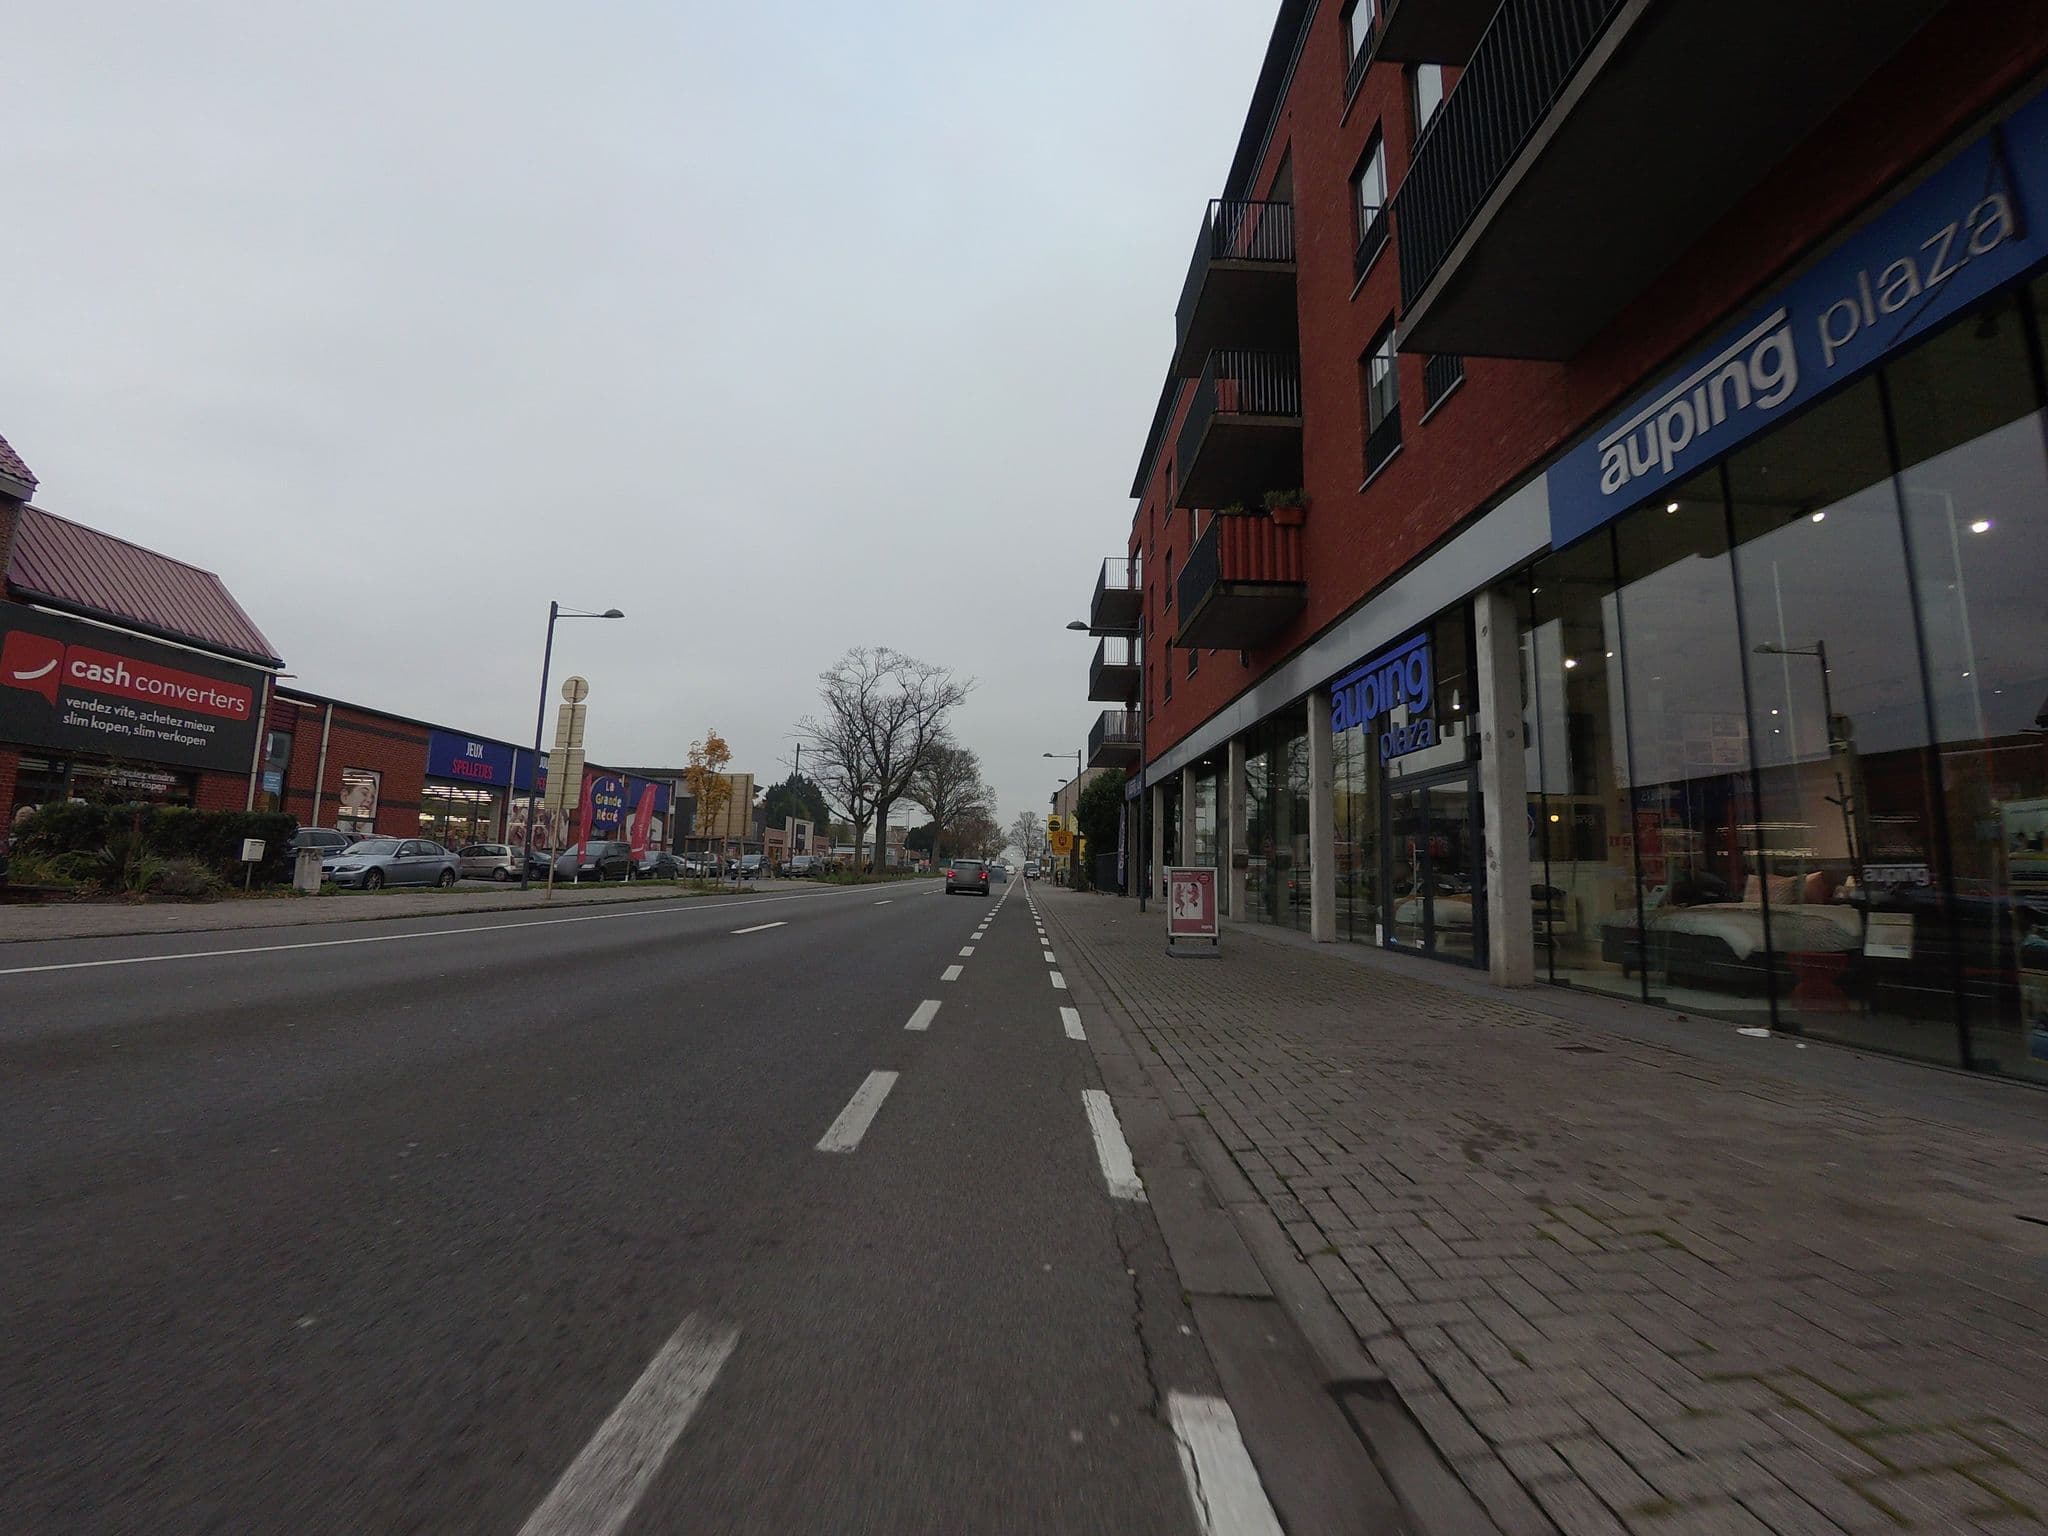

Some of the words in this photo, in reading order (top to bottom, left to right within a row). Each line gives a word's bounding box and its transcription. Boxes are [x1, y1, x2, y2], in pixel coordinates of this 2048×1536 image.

[1598, 306, 1800, 496] auping
[1816, 192, 2016, 369] plaza
[71, 660, 131, 688] cash
[135, 675, 245, 712] converters
[1331, 632, 1430, 733] auping
[62, 711, 89, 727] slim
[91, 718, 132, 736] kopen,
[134, 723, 156, 739] slim
[157, 729, 207, 747] verkopen
[66, 698, 112, 715] vendez
[114, 705, 138, 721] vite,
[139, 709, 183, 728] achetez
[183, 719, 216, 734] mieux
[466, 742, 484, 759] JEUX
[1380, 718, 1433, 767] plaza
[595, 794, 622, 807] Grande
[605, 780, 615, 792] La
[596, 808, 618, 822] Récré
